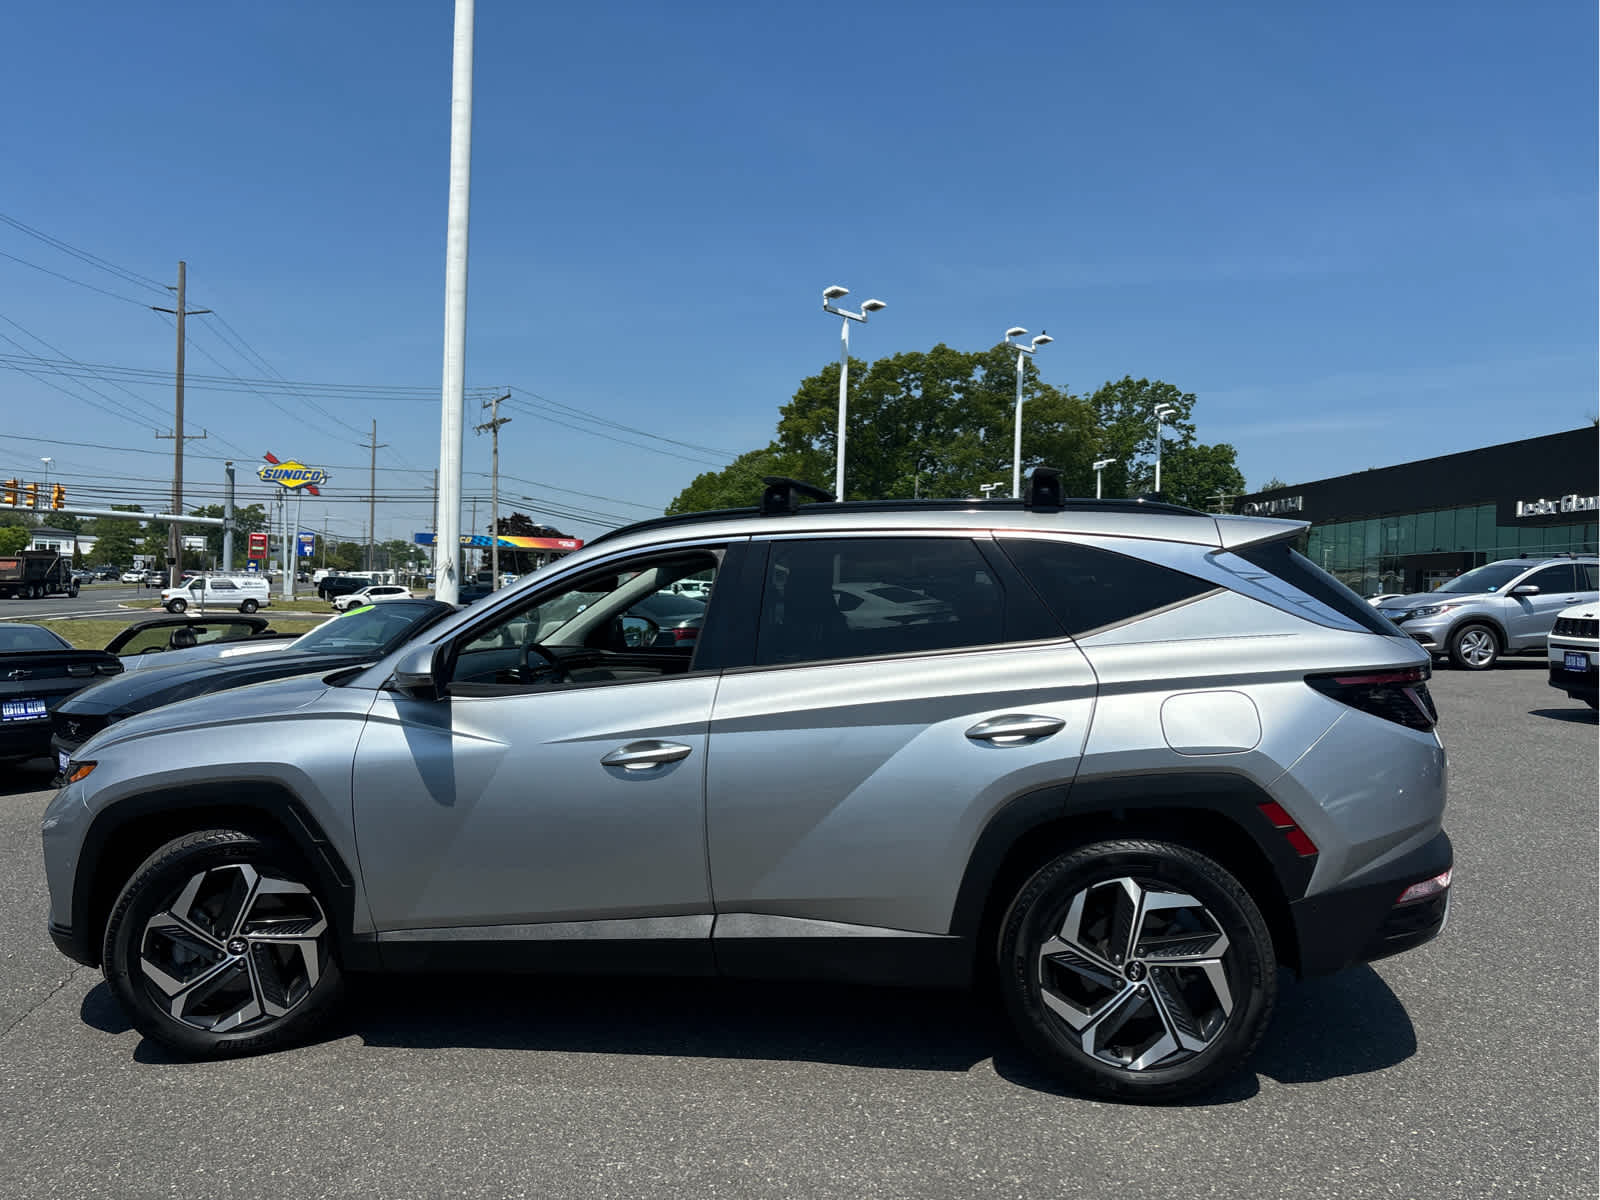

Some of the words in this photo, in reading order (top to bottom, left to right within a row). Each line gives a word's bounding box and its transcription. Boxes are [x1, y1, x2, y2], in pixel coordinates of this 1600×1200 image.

[263, 469, 321, 481] SUNOCO
[1516, 498, 1560, 517] Lester
[432, 535, 472, 544] SCO
